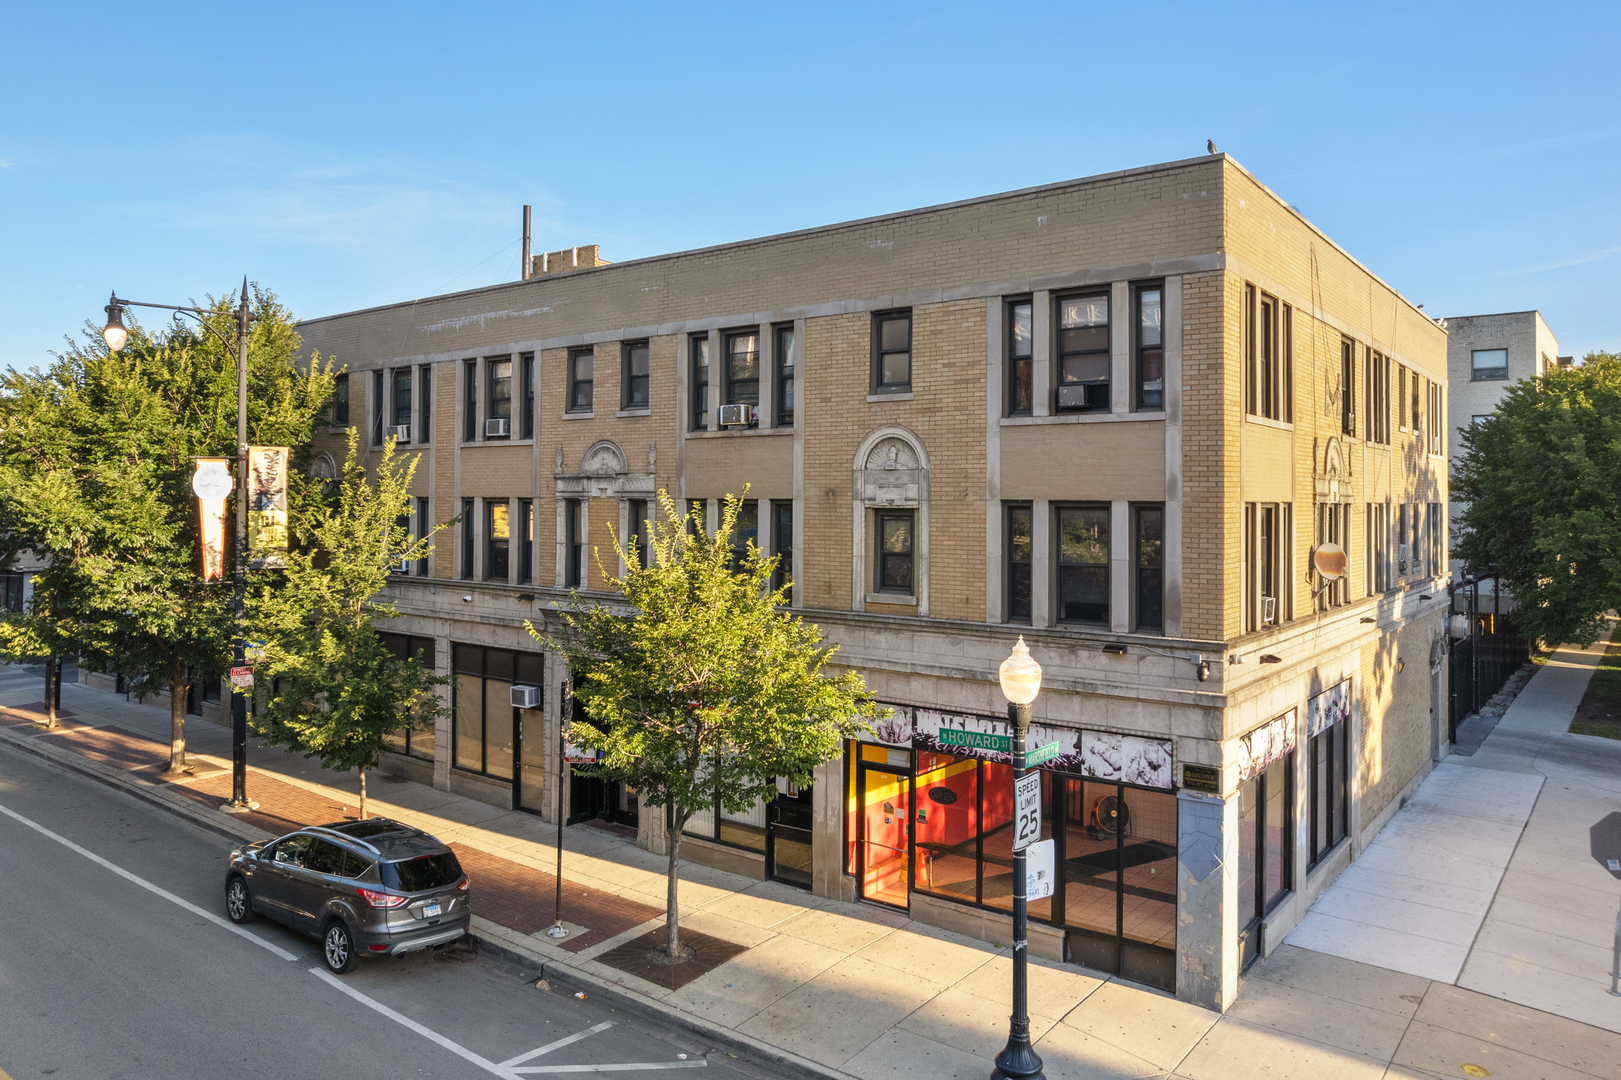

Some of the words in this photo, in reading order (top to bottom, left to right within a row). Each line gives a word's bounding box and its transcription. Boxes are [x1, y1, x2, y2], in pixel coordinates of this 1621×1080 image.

[948, 731, 1000, 749] HOWARD
[1001, 740, 1009, 748] ST
[1028, 745, 1055, 766] MARSHFIELD
[930, 789, 956, 802] OPEN
[1017, 778, 1039, 797] SPEED
[1020, 793, 1037, 811] LIMIT
[1019, 808, 1038, 841] 25
